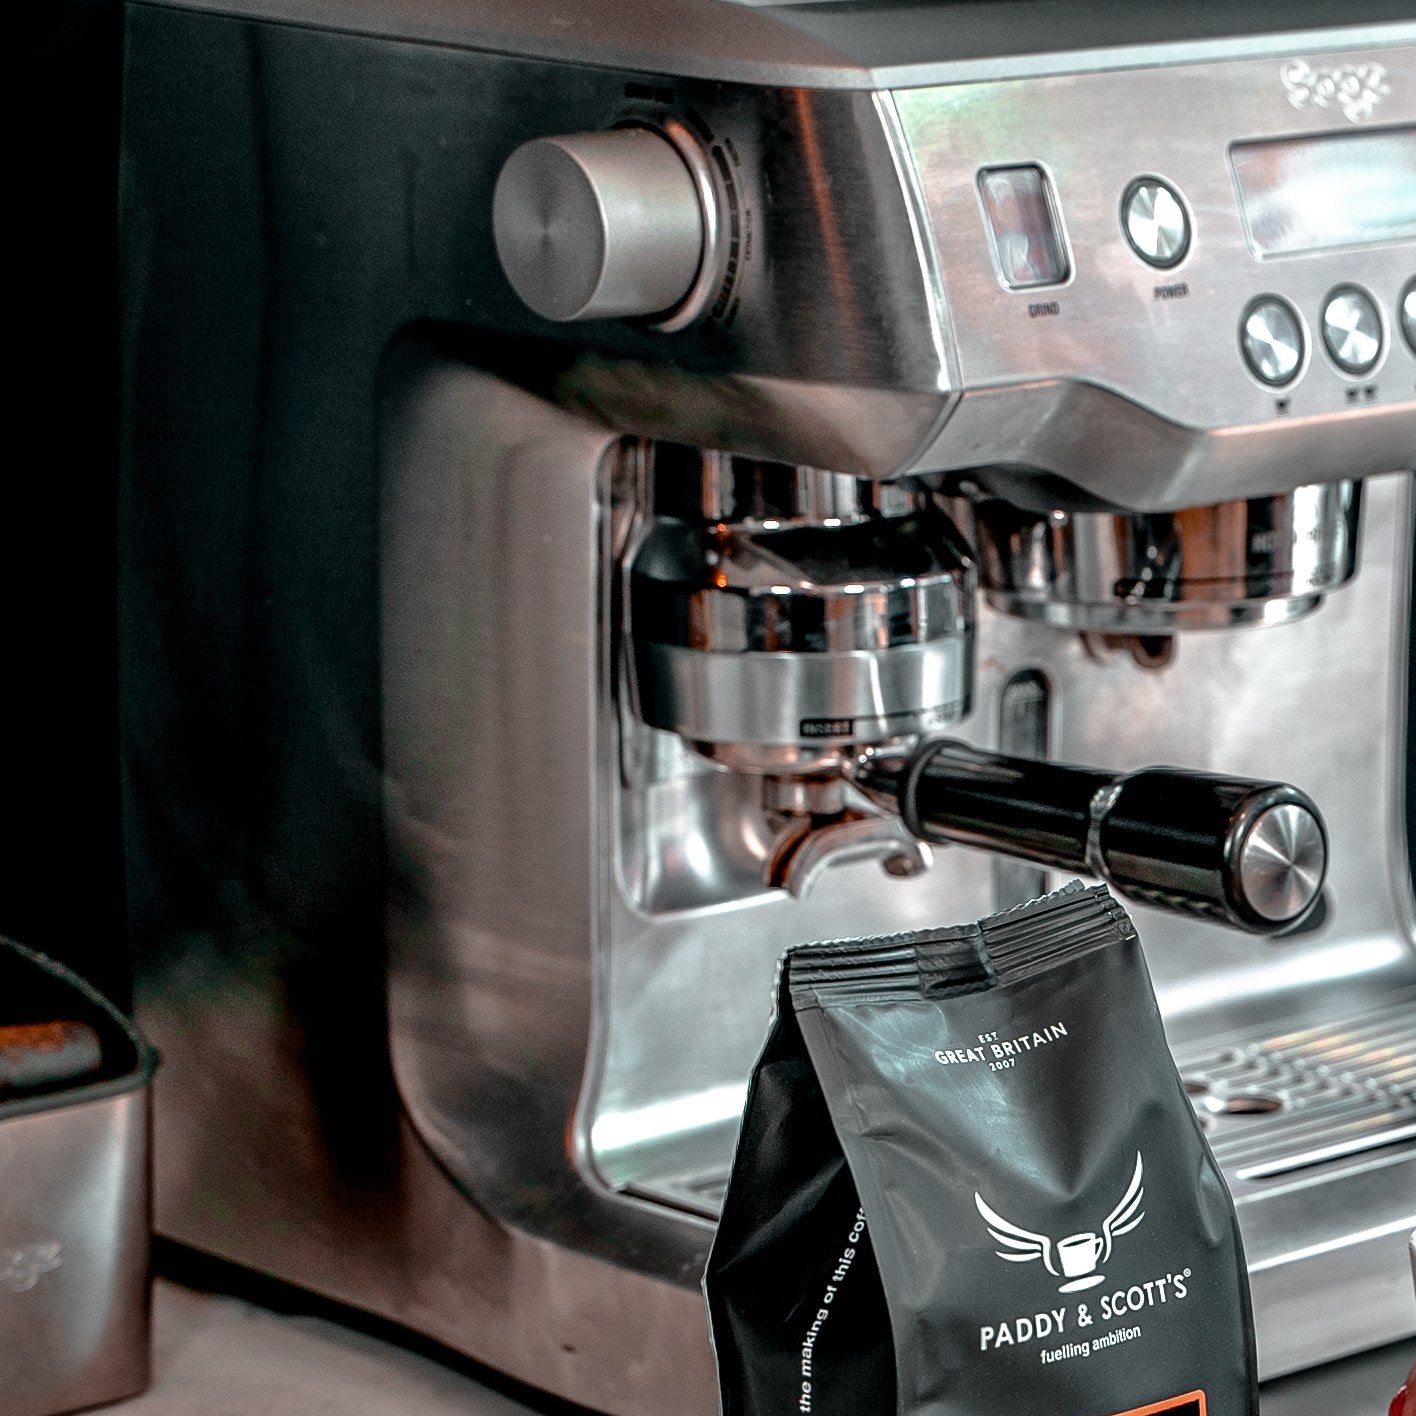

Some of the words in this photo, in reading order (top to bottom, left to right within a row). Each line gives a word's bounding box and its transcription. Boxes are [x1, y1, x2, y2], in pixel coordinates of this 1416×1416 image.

[1153, 283, 1189, 300] POWER
[934, 1047, 986, 1065] GREAT
[991, 1022, 1068, 1058] BRITAIN
[977, 1031, 998, 1043] EST
[989, 1058, 1015, 1072] 2007
[832, 1247, 856, 1282] this
[823, 1284, 838, 1304] of
[801, 1308, 829, 1377] making
[980, 1307, 1066, 1350] PADDY
[1078, 1304, 1093, 1327] &
[1040, 1341, 1090, 1364] fuelling
[1092, 1326, 1141, 1351] ambition
[799, 1381, 812, 1413] the
